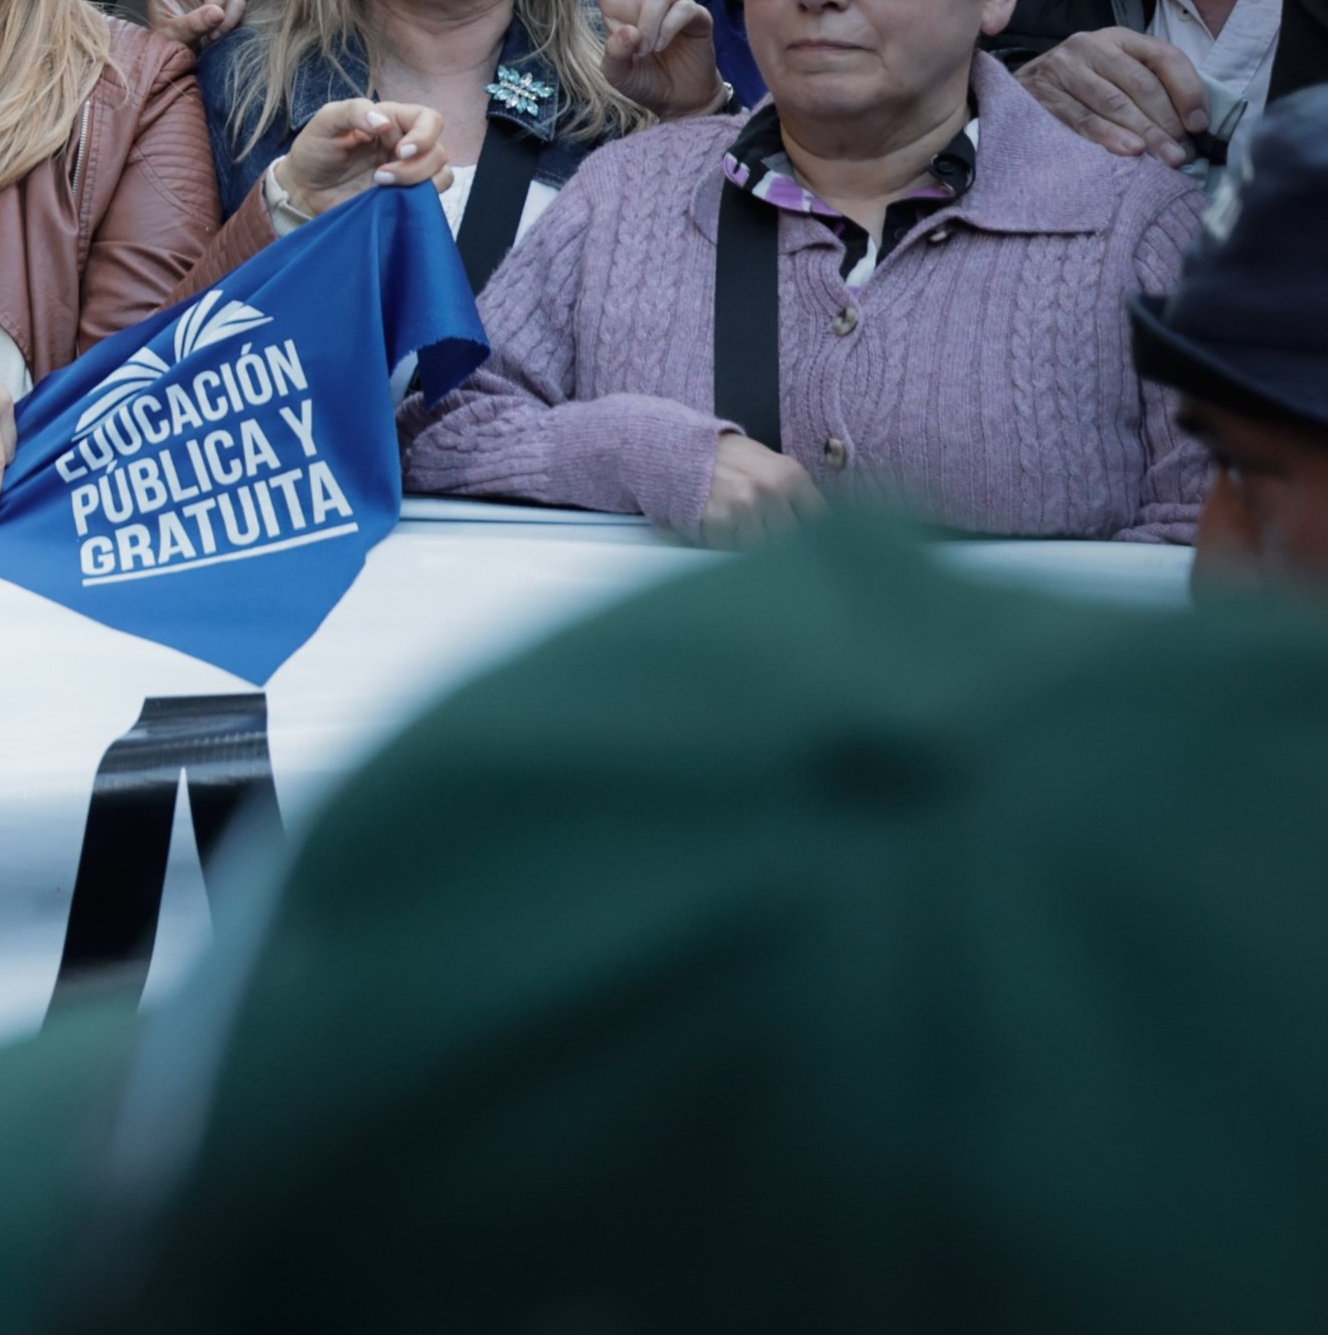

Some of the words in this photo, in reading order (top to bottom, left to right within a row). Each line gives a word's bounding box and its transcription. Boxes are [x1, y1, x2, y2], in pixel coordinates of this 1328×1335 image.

[54, 338, 309, 483] EDUCACIÓN
[70, 417, 282, 538] PÚBLICA
[278, 398, 318, 458] Y
[79, 459, 354, 576] GRATUITA
